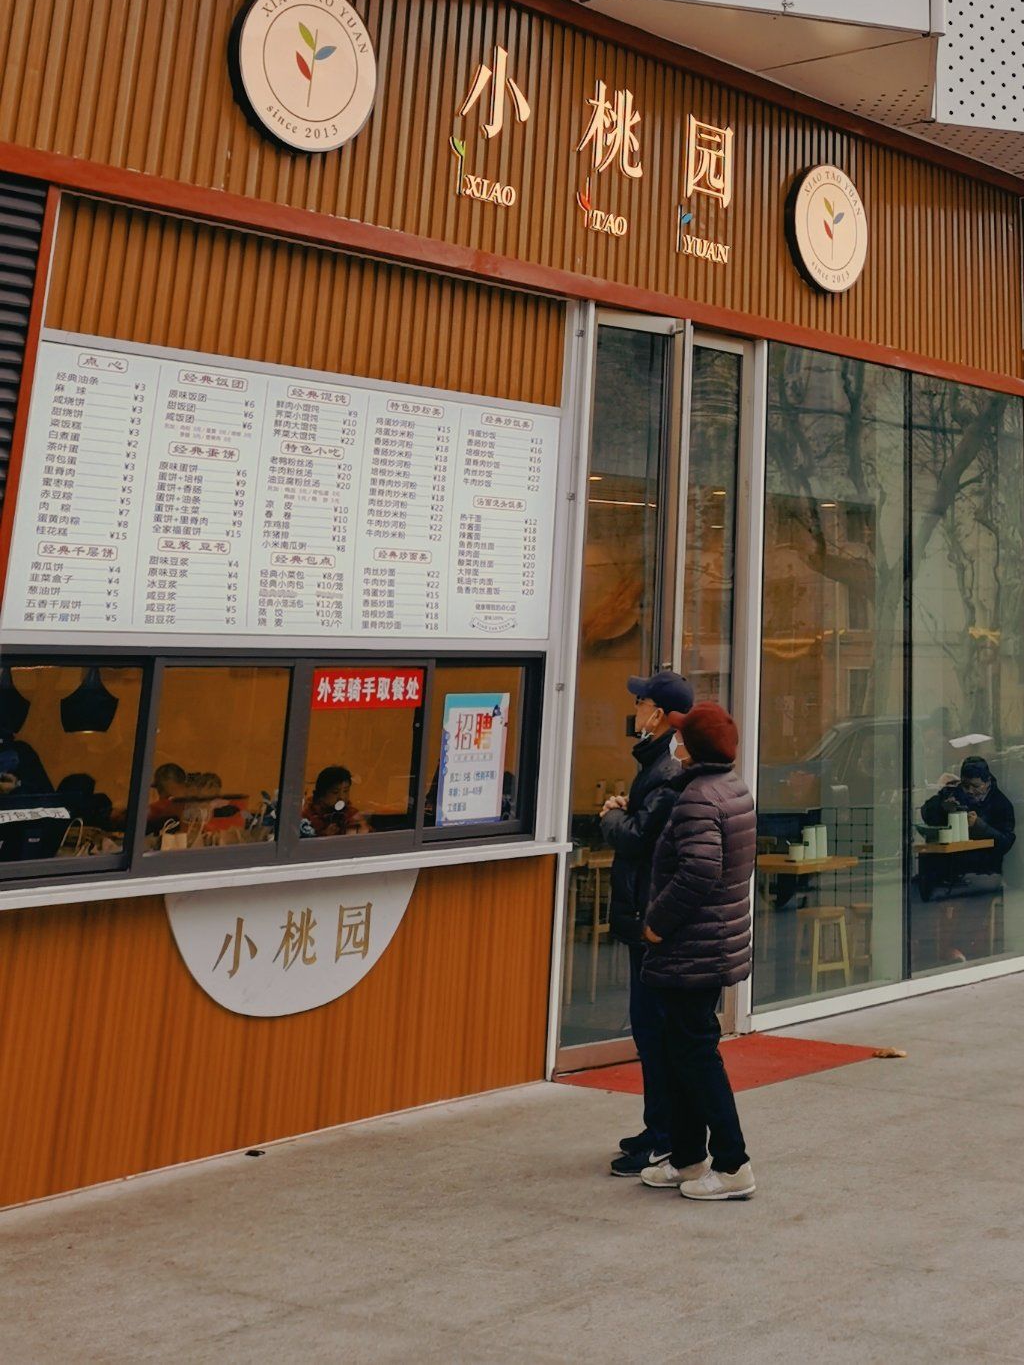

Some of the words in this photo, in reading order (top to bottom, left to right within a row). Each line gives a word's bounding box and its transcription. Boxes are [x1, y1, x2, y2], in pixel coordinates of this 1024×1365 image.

[337, 7, 369, 55] YUAN
[266, 105, 299, 134] since
[304, 124, 340, 140] 2013
[454, 44, 735, 210] 小桃园
[462, 174, 518, 208] XIAO
[589, 208, 630, 238] TAO
[681, 233, 730, 266] YUAN
[83, 356, 124, 370] 点心
[56, 372, 98, 385] 经典油条
[134, 383, 146, 391] ¥3
[183, 373, 244, 389] 经典饭团
[52, 396, 85, 406] 咸烧饼
[169, 389, 207, 402] 原味饭团
[244, 400, 255, 408] ¥6
[291, 389, 346, 403] 经典馄饨
[51, 407, 83, 418] 甜烧饼
[167, 401, 196, 412] 甜饭团
[243, 411, 253, 419] ¥6
[276, 401, 320, 413] 鲜肉小馄饨
[165, 413, 195, 423] 咸饭团
[243, 422, 252, 430] ¥6
[343, 419, 357, 427] ¥10
[274, 420, 317, 432] 鲜肉大馄饨
[342, 428, 355, 436] ¥20
[48, 430, 80, 442] 白煮蛋
[127, 440, 138, 448] ¥2
[341, 437, 355, 445] ¥22
[47, 442, 79, 453] 茶叶蛋
[172, 445, 235, 459] 经典蛋饼
[285, 444, 341, 457] 特色小吃
[45, 454, 77, 465] 荷包蛋
[270, 456, 314, 467] 老鸭粉丝汤
[159, 461, 198, 472] 原味蛋饼
[269, 466, 313, 477] 牛肉粉丝汤
[44, 466, 75, 476] 里脊肉
[123, 474, 133, 482] ¥3
[42, 478, 74, 488] 蜜枣粽
[236, 480, 246, 488] ¥9
[336, 482, 350, 490] ¥20
[41, 490, 72, 500] 赤豆粽
[120, 497, 131, 505] ¥5
[156, 493, 201, 504] 蛋饼+油条
[155, 503, 200, 514] 蛋饼+生菜
[37, 513, 80, 525] 蛋黄肉粽
[117, 520, 128, 528] ¥8
[154, 514, 208, 526] 蛋饼+里脊肉
[36, 525, 68, 536] 桂花糕
[110, 532, 127, 540] ¥15
[152, 525, 202, 536] 全家福蛋饼
[226, 530, 241, 538] ¥15
[42, 544, 114, 558] 经典千层饼
[150, 556, 189, 566] 甜味豆浆
[228, 560, 239, 568] ¥4
[275, 555, 332, 566] 经典包点
[31, 562, 63, 572] 南瓜饼
[148, 568, 188, 578] 原味豆浆
[30, 574, 72, 583] 韭菜盒子
[147, 580, 177, 589] 冰豆浆
[28, 586, 60, 596] 葱油饼
[146, 592, 176, 600] 咸豆浆
[26, 599, 81, 608] 五香千层饼
[146, 604, 176, 612] 咸豆花
[24, 613, 80, 622] 酱香千层饼
[145, 615, 175, 624] 甜豆花
[317, 676, 420, 702] 外卖骑手取餐处
[212, 902, 372, 979] 小桃园
